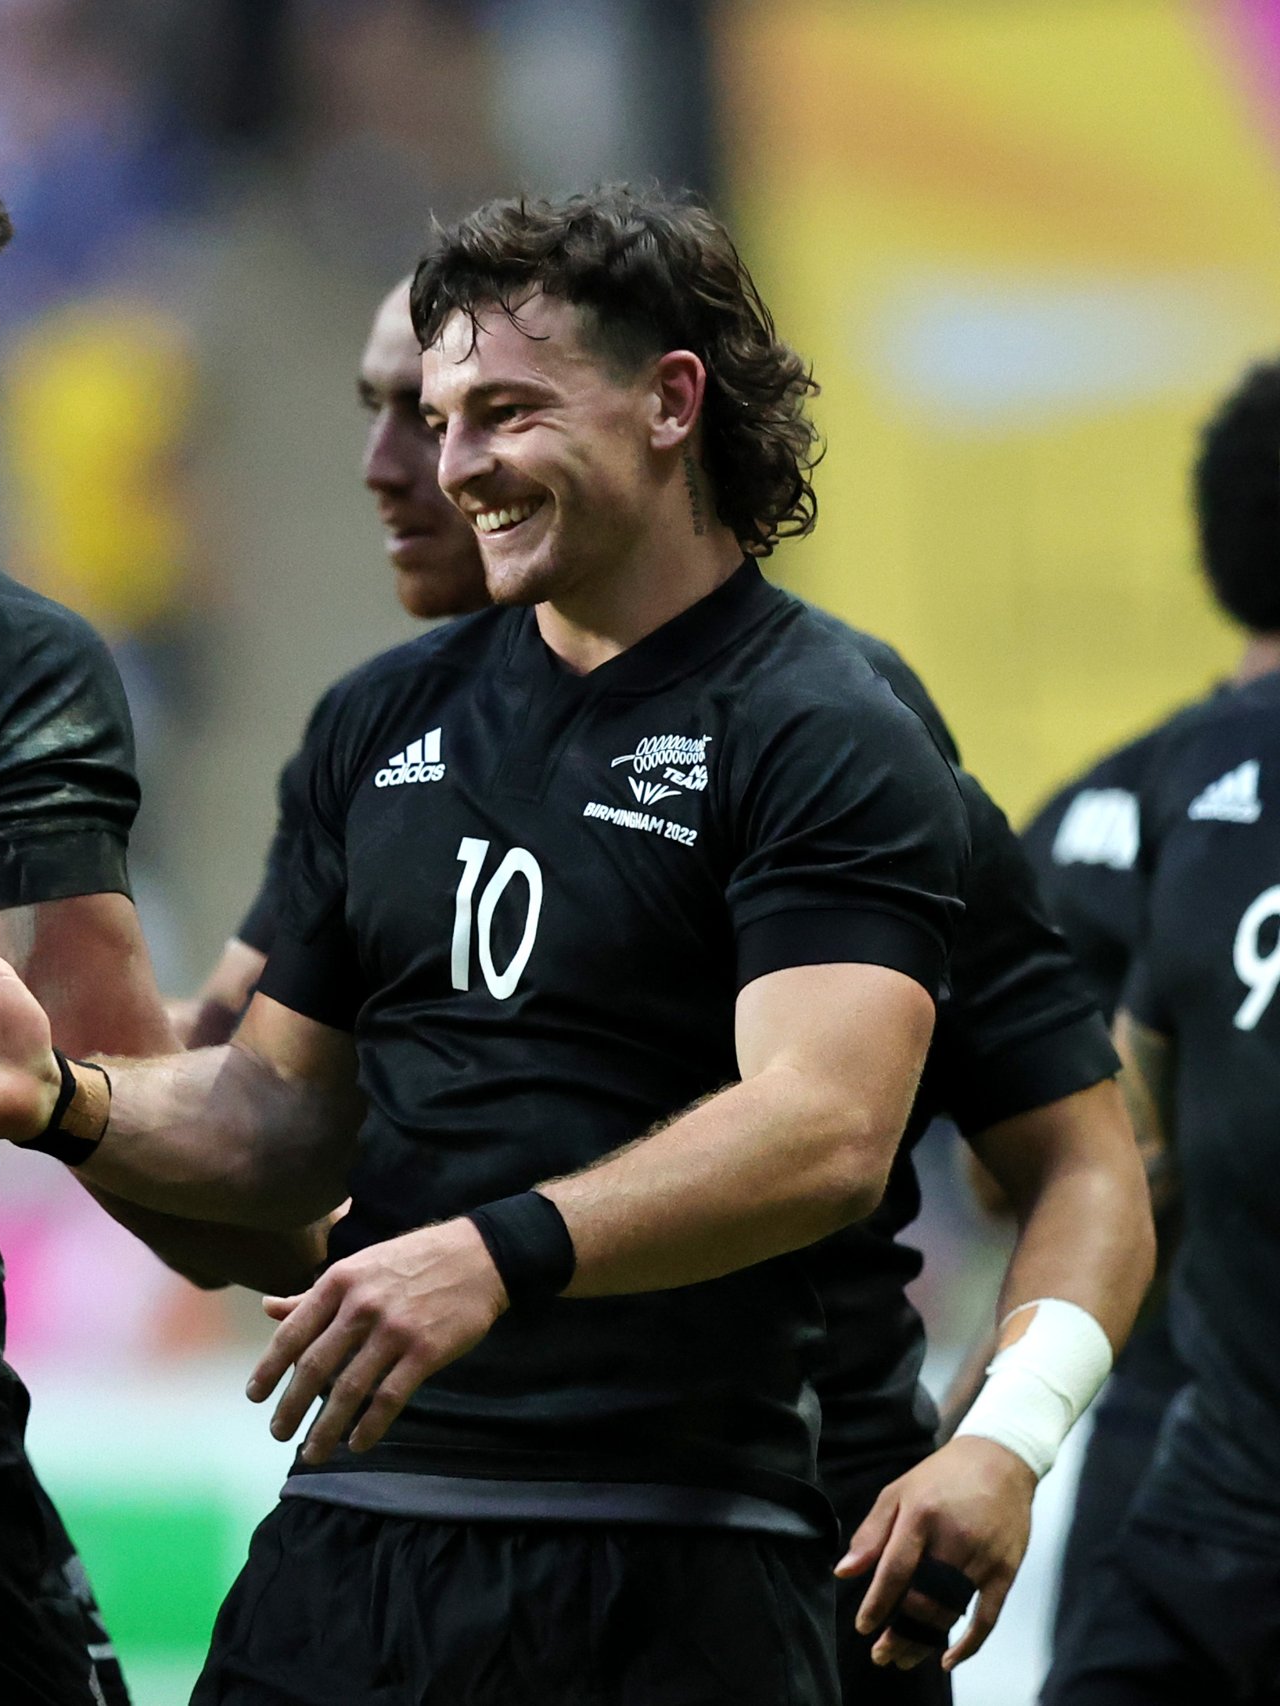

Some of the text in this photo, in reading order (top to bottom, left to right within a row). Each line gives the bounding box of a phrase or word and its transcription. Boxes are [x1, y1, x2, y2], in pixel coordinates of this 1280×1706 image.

[374, 762, 446, 788] adidas
[662, 766, 709, 791] TEAM
[582, 801, 698, 847] BIRMINGHAM 2022
[450, 836, 544, 1001] 10
[1232, 884, 1280, 1031] 9
